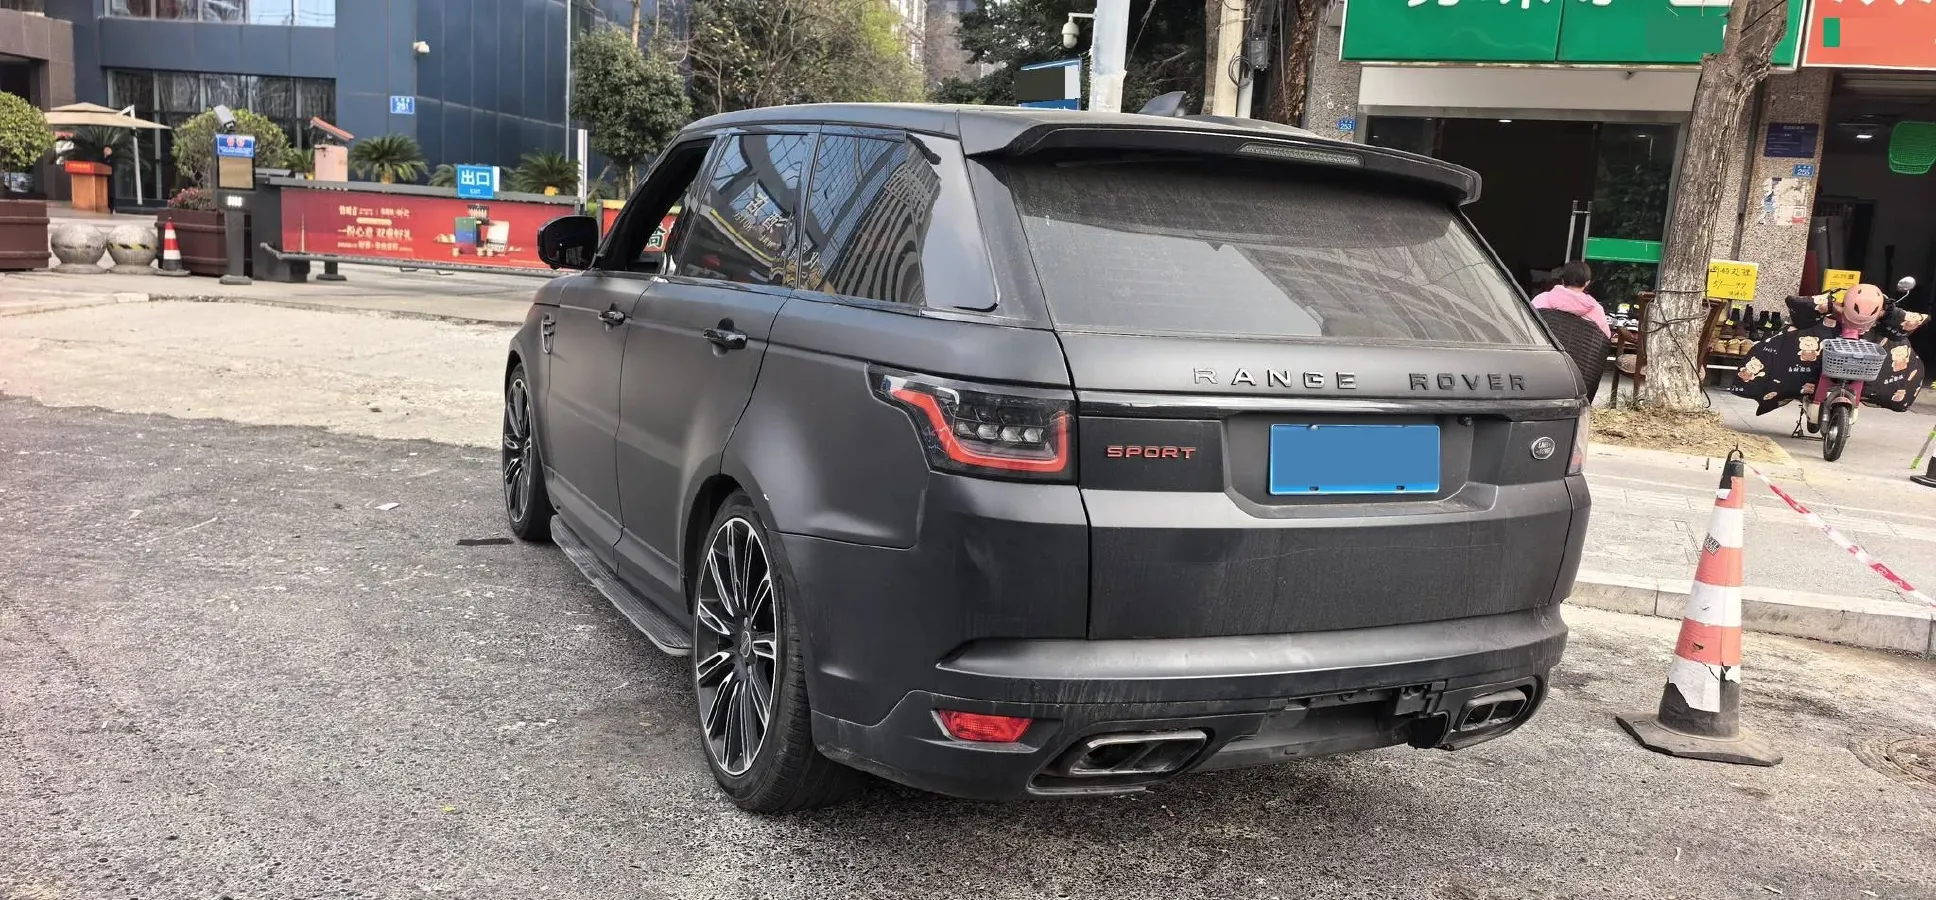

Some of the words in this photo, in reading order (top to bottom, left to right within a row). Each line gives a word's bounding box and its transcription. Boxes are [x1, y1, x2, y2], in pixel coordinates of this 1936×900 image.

[461, 169, 490, 186] 出口
[1193, 367, 1357, 390] RANGE
[1408, 372, 1526, 391] ROVER
[1107, 445, 1196, 459] SPORT
